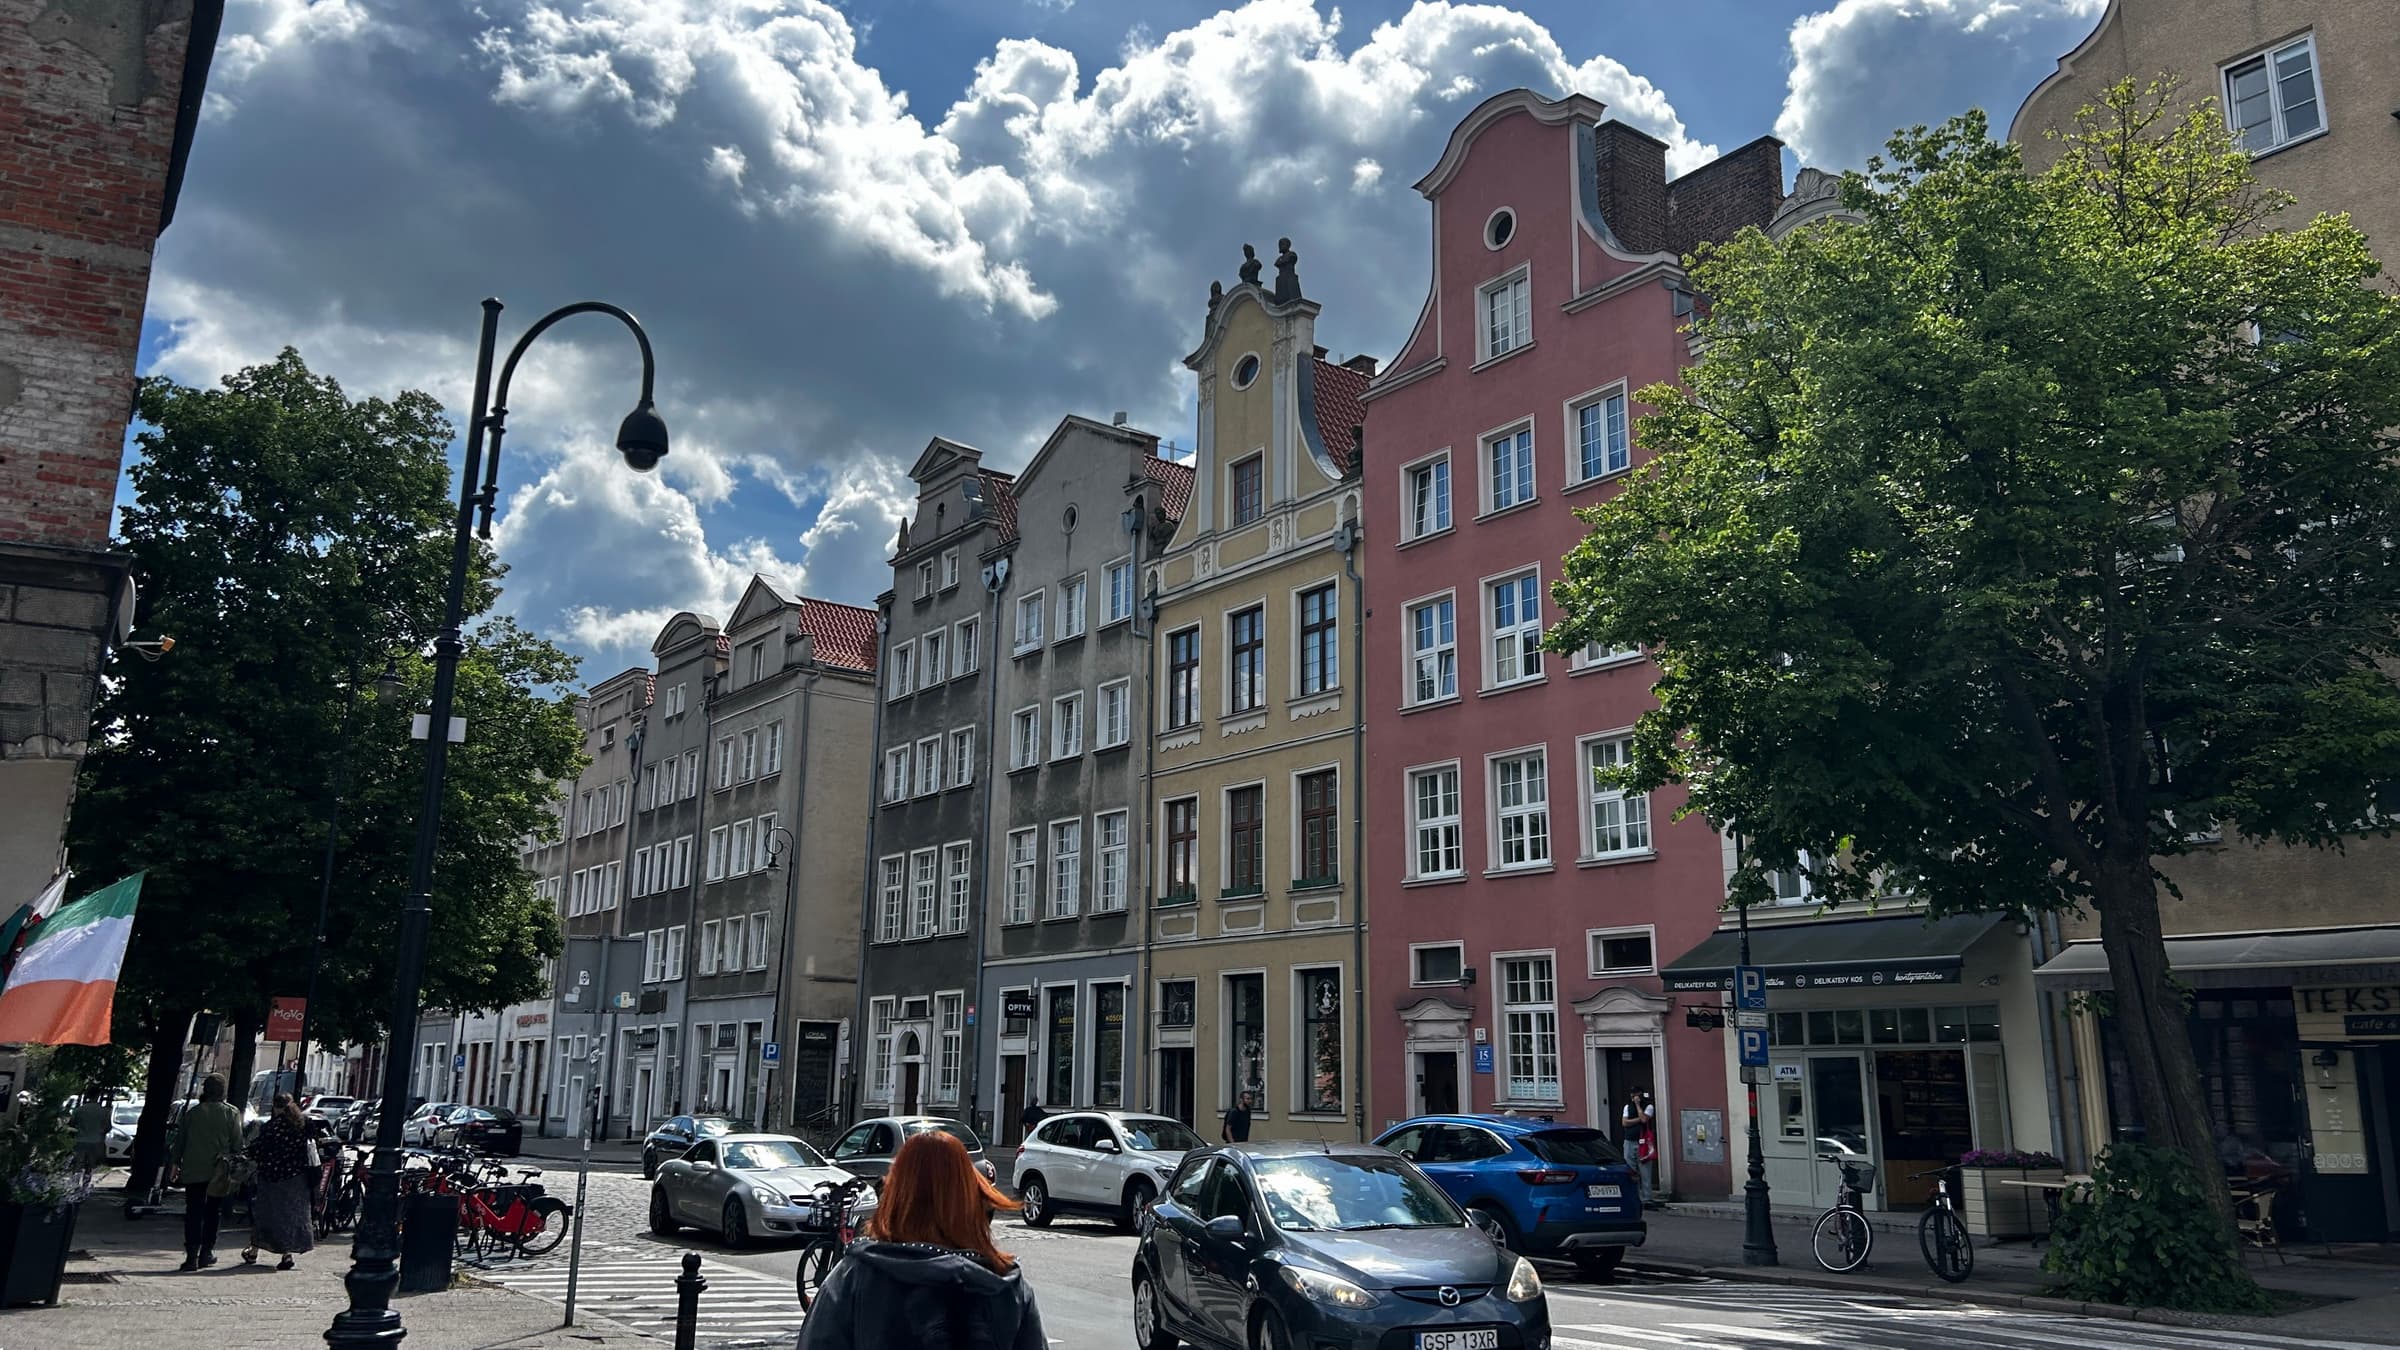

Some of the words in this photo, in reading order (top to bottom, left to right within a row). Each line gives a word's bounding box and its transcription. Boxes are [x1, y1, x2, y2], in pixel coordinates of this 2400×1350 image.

[1674, 981, 1705, 989] DELIKATESY
[1742, 970, 1759, 998] P
[1814, 977, 1849, 985] DELIKATESY
[1008, 1003, 1032, 1012] OPTYK
[766, 1044, 776, 1058] P
[1744, 1032, 1760, 1060] P
[1479, 1050, 1488, 1060] 15
[1780, 1067, 1797, 1075] ATM
[1423, 1333, 1456, 1350] GSP
[1462, 1331, 1496, 1349] 13XR
